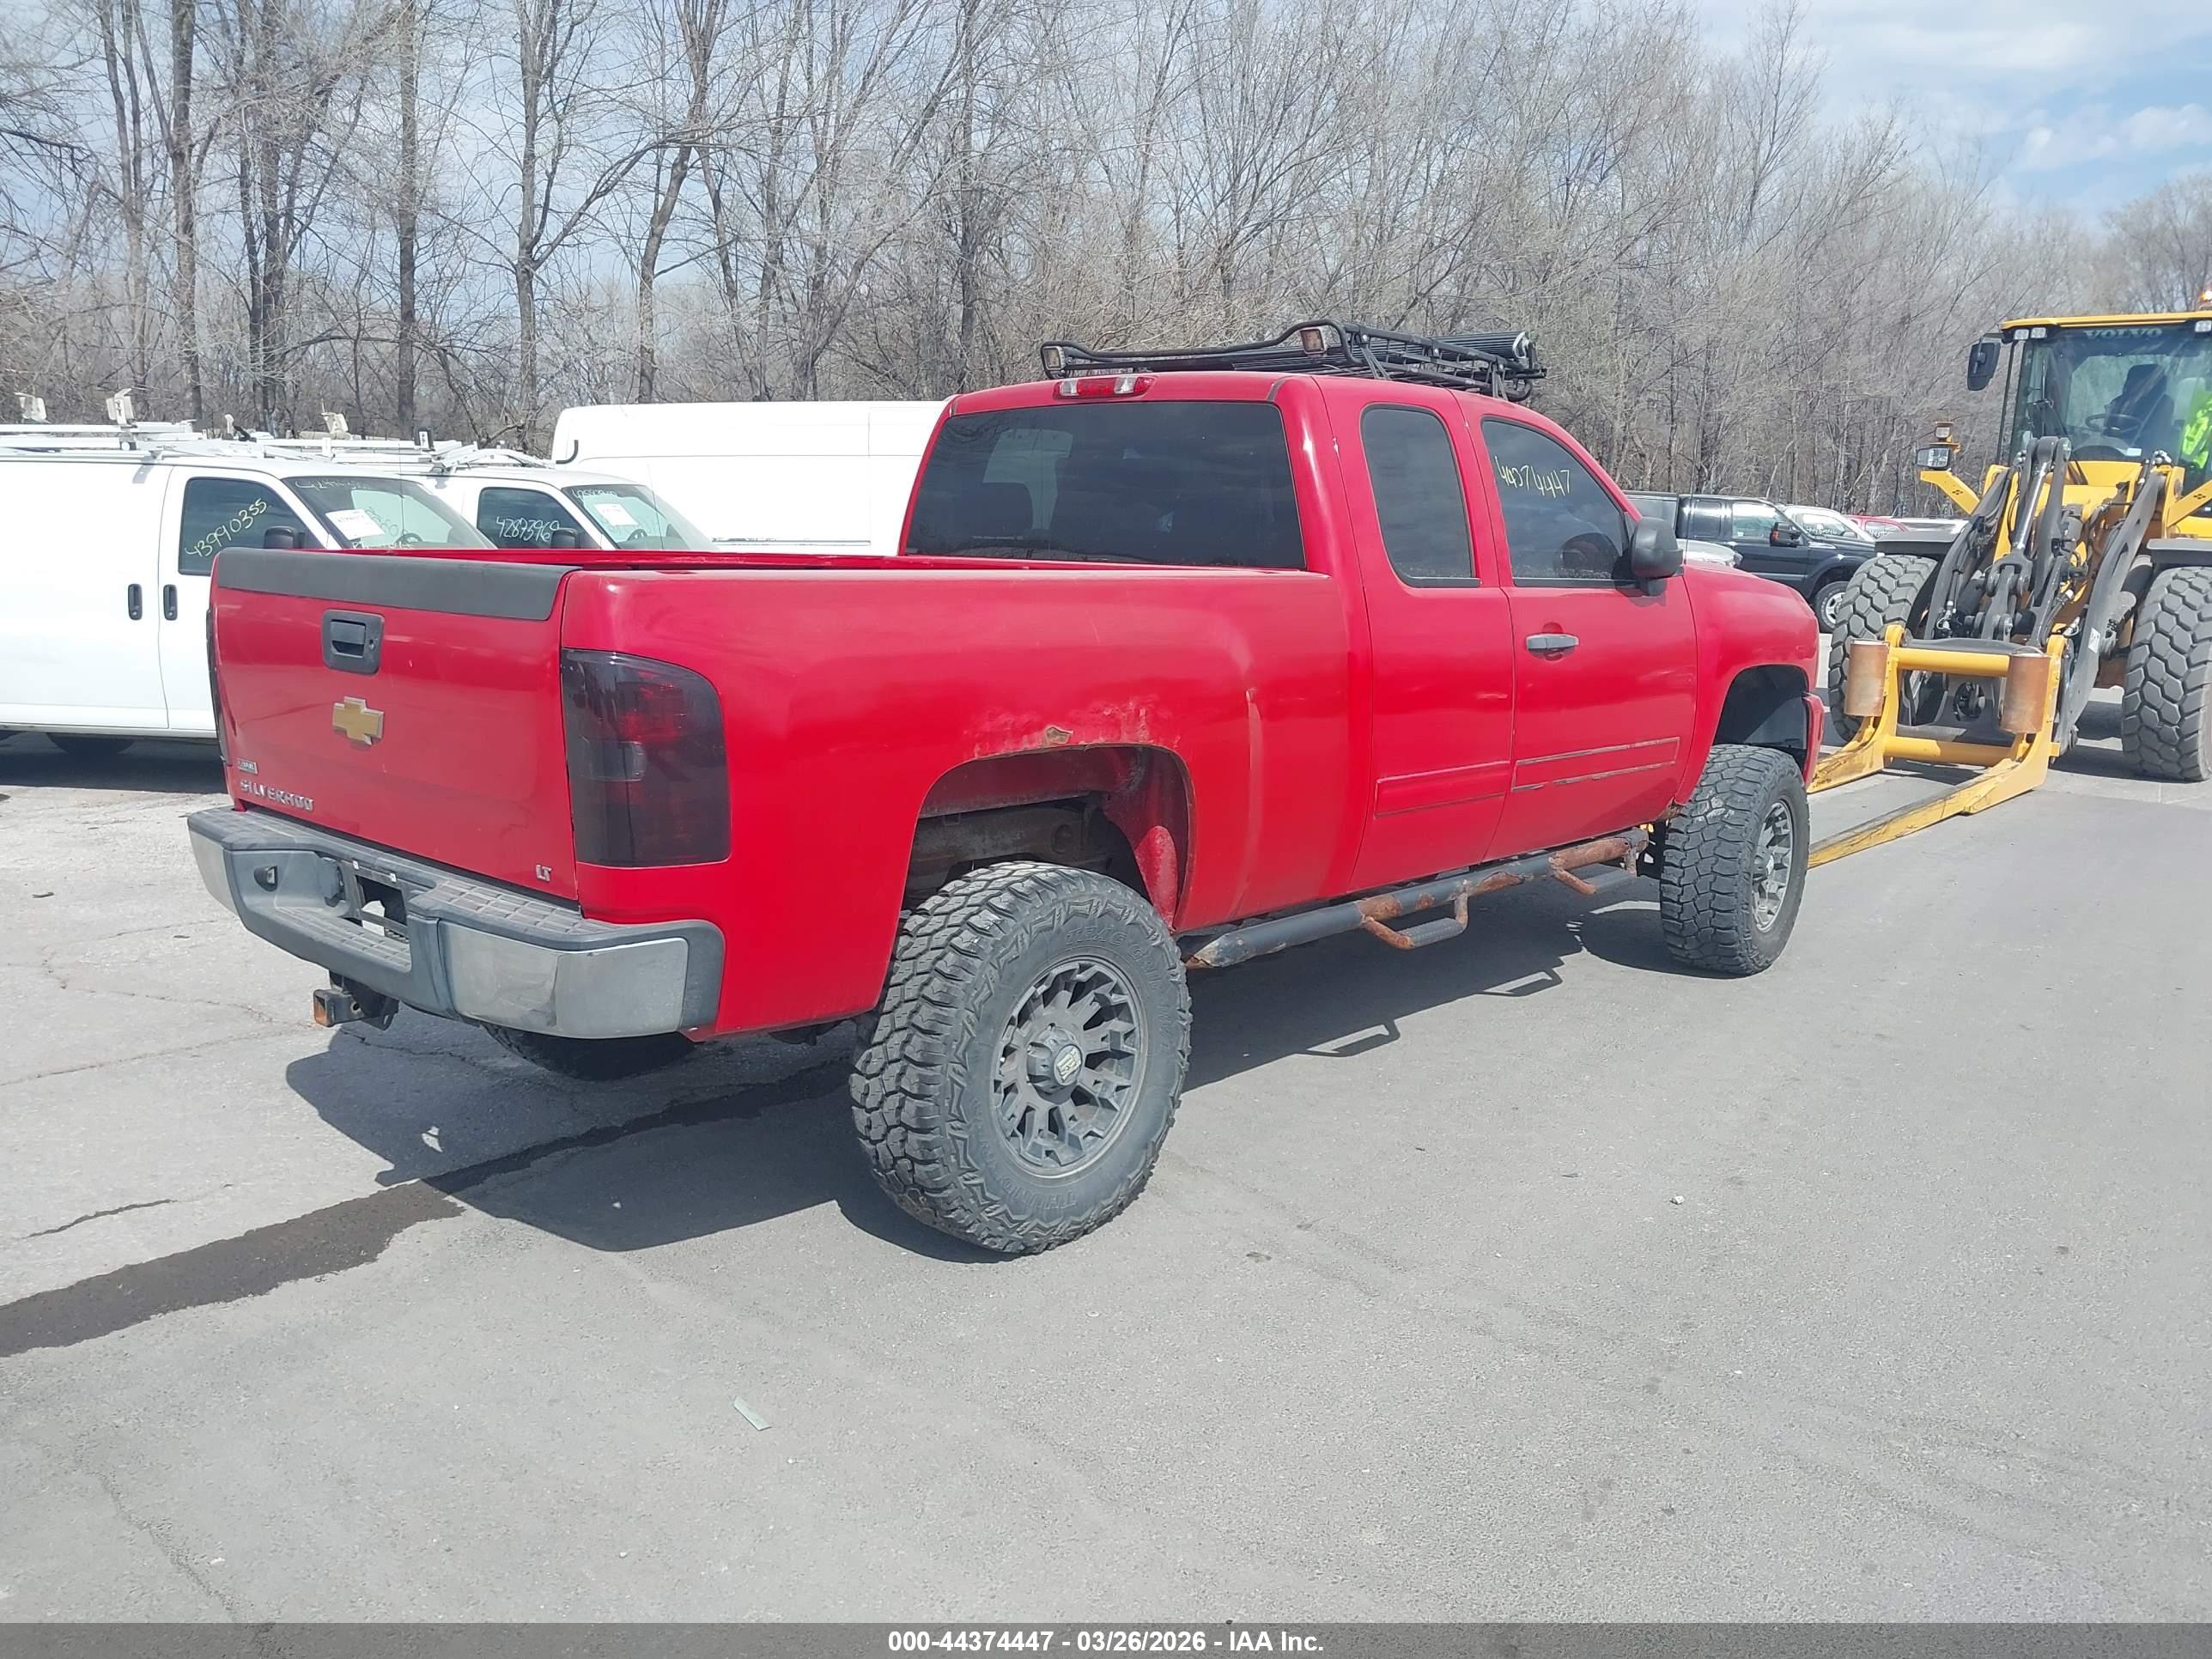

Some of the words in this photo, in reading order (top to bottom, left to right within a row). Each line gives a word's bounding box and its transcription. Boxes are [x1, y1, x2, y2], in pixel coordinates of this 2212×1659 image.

[2082, 327, 2163, 339] VOLVO
[1494, 455, 1570, 498] 44374447
[184, 497, 267, 556] 43990355
[240, 779, 314, 811] SILVERADO
[536, 864, 552, 882] LT
